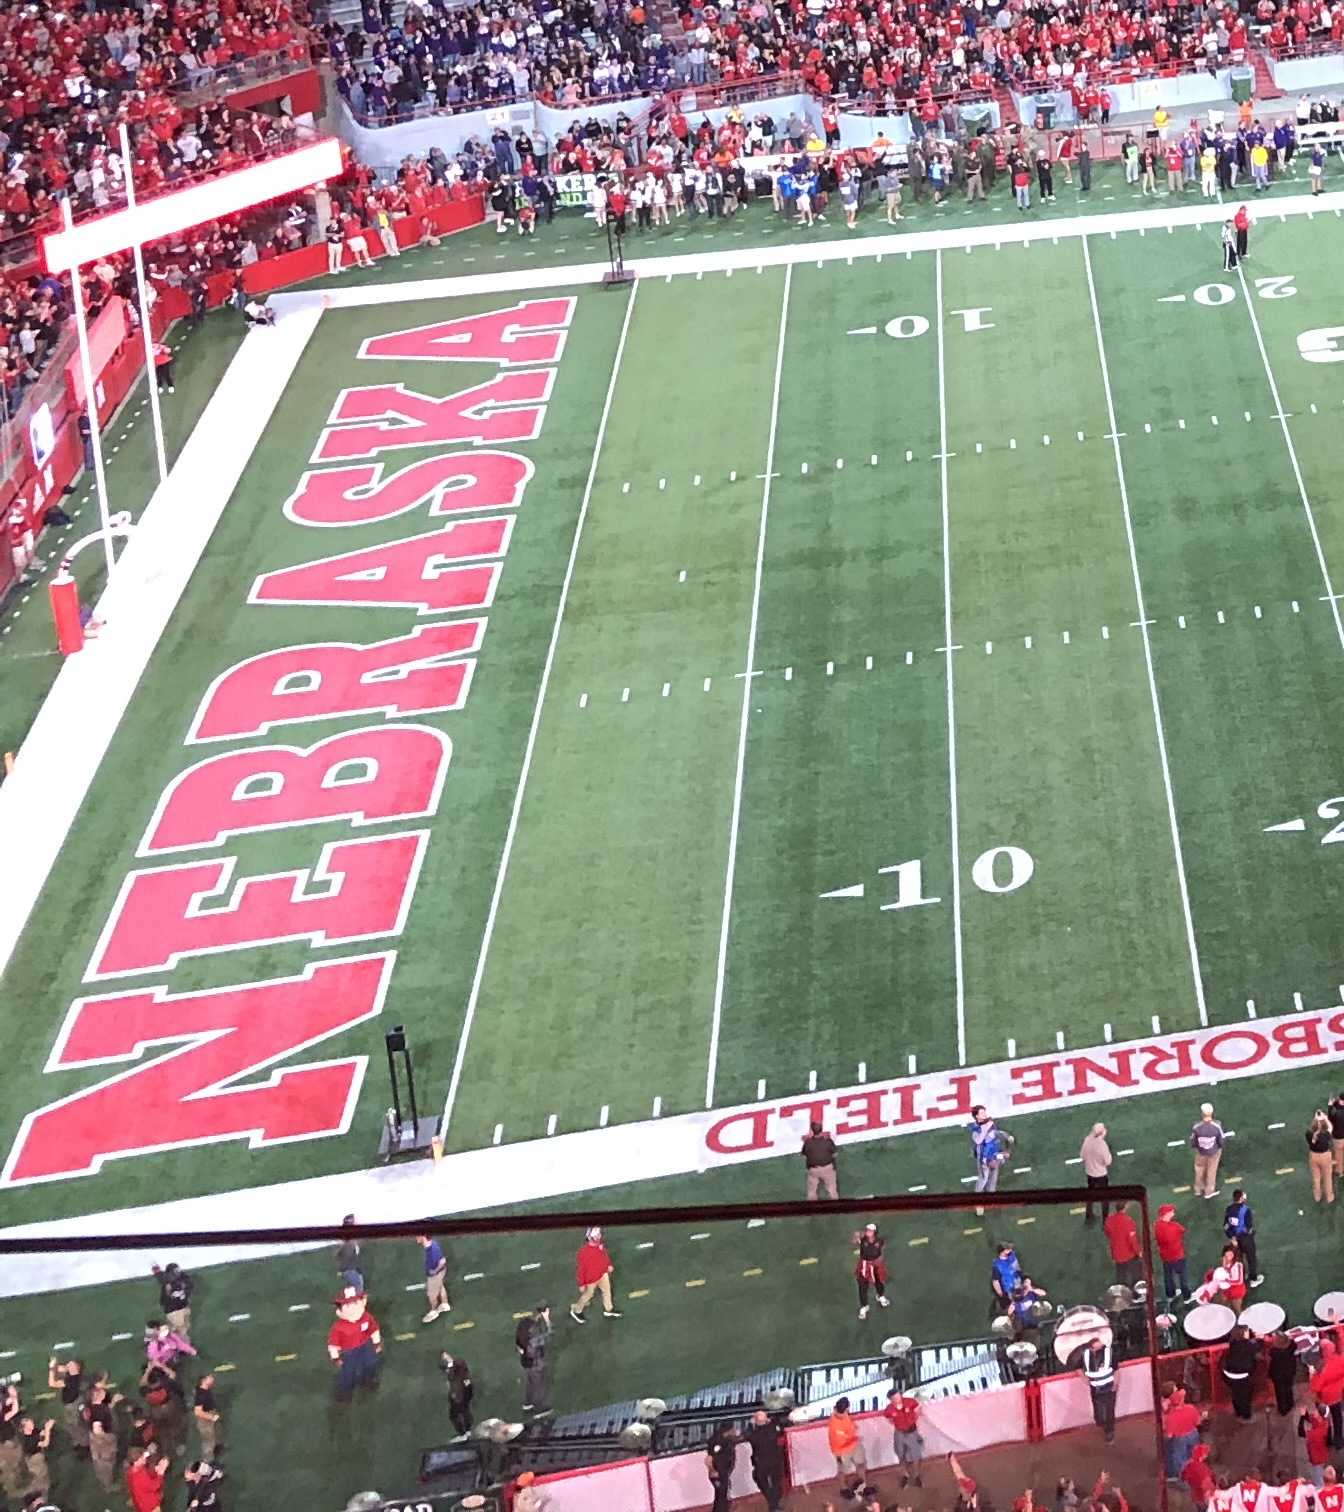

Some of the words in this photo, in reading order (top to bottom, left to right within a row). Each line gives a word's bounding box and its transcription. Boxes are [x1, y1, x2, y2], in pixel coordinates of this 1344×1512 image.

[1193, 275, 1298, 306] 20
[885, 306, 996, 339] 10
[0, 295, 579, 1188] NEBRASKA
[878, 846, 1035, 912] 10
[704, 1072, 978, 1155] FIELD
[1241, 1488, 1256, 1503] N
[1324, 1493, 1338, 1508] N
